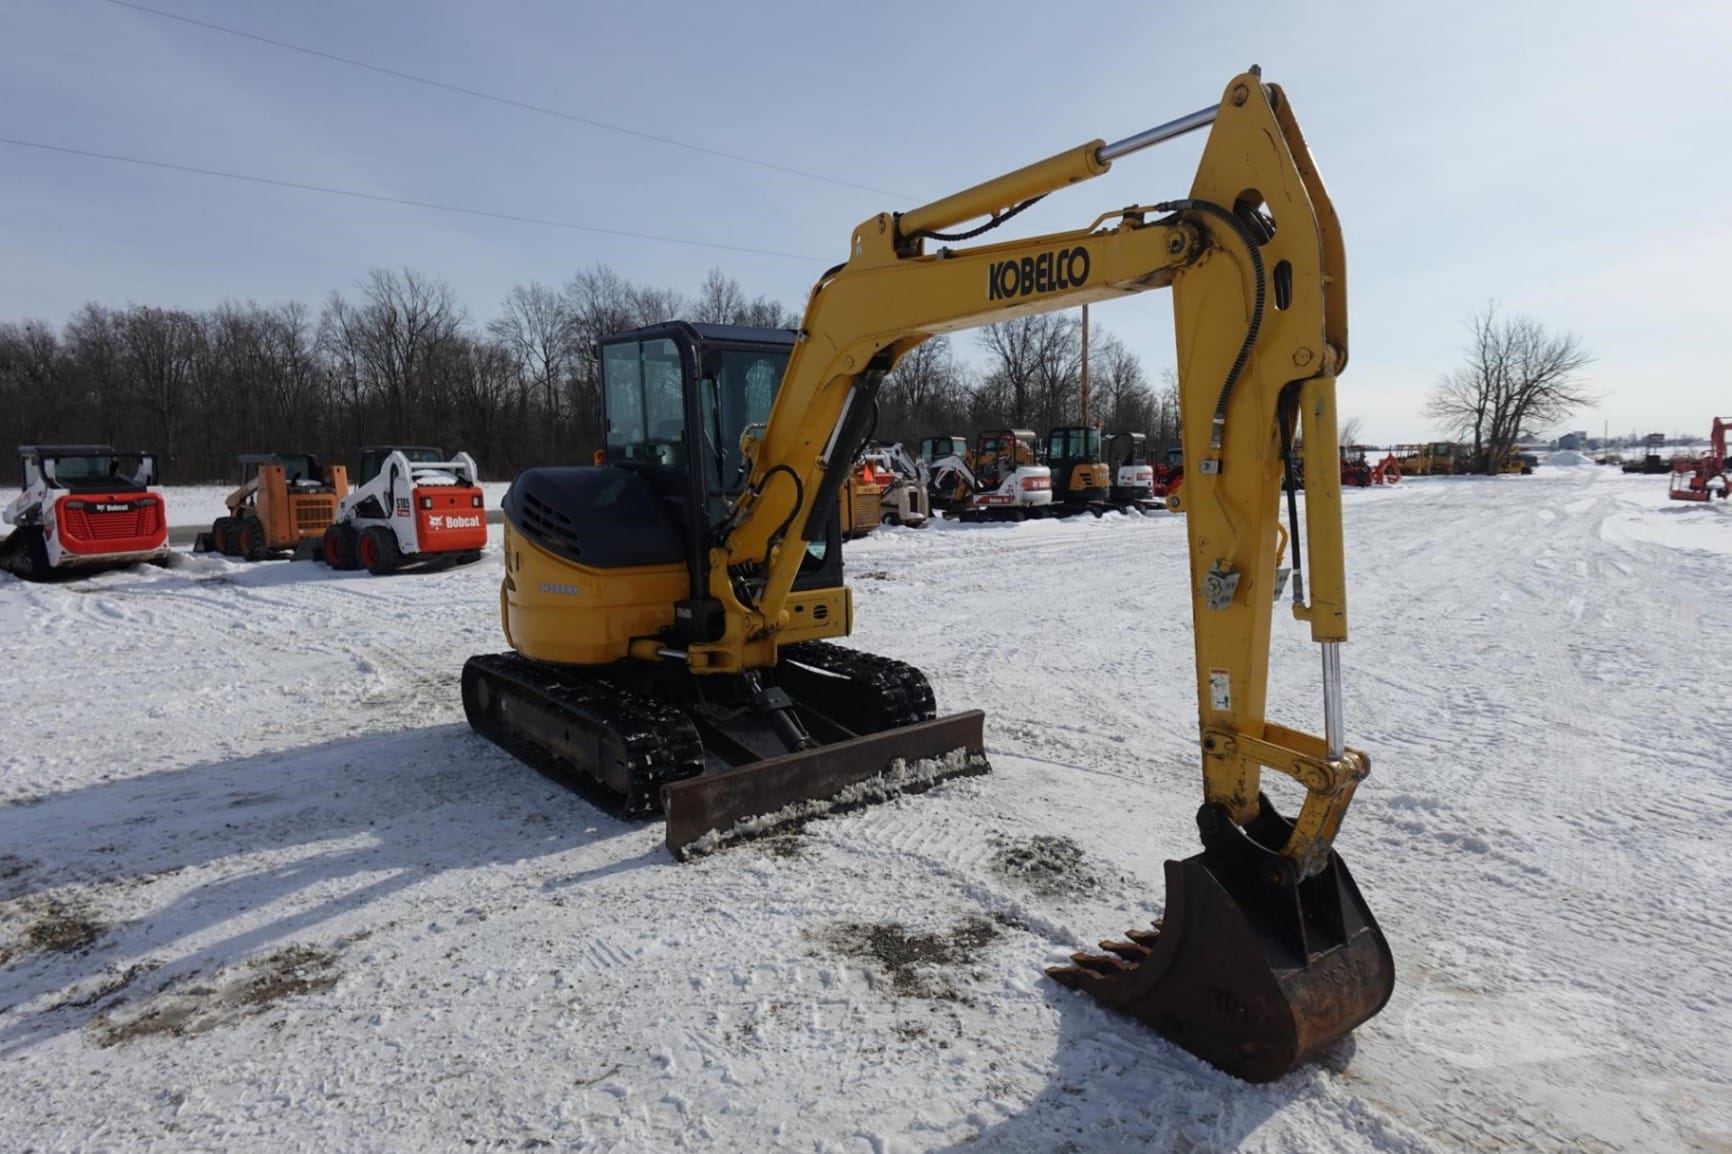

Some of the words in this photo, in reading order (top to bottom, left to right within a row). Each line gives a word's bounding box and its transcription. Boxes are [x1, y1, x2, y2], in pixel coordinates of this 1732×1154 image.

[989, 246, 1090, 301] KOBELCO
[106, 503, 128, 511] Bobcat
[445, 515, 480, 529] Bobcat
